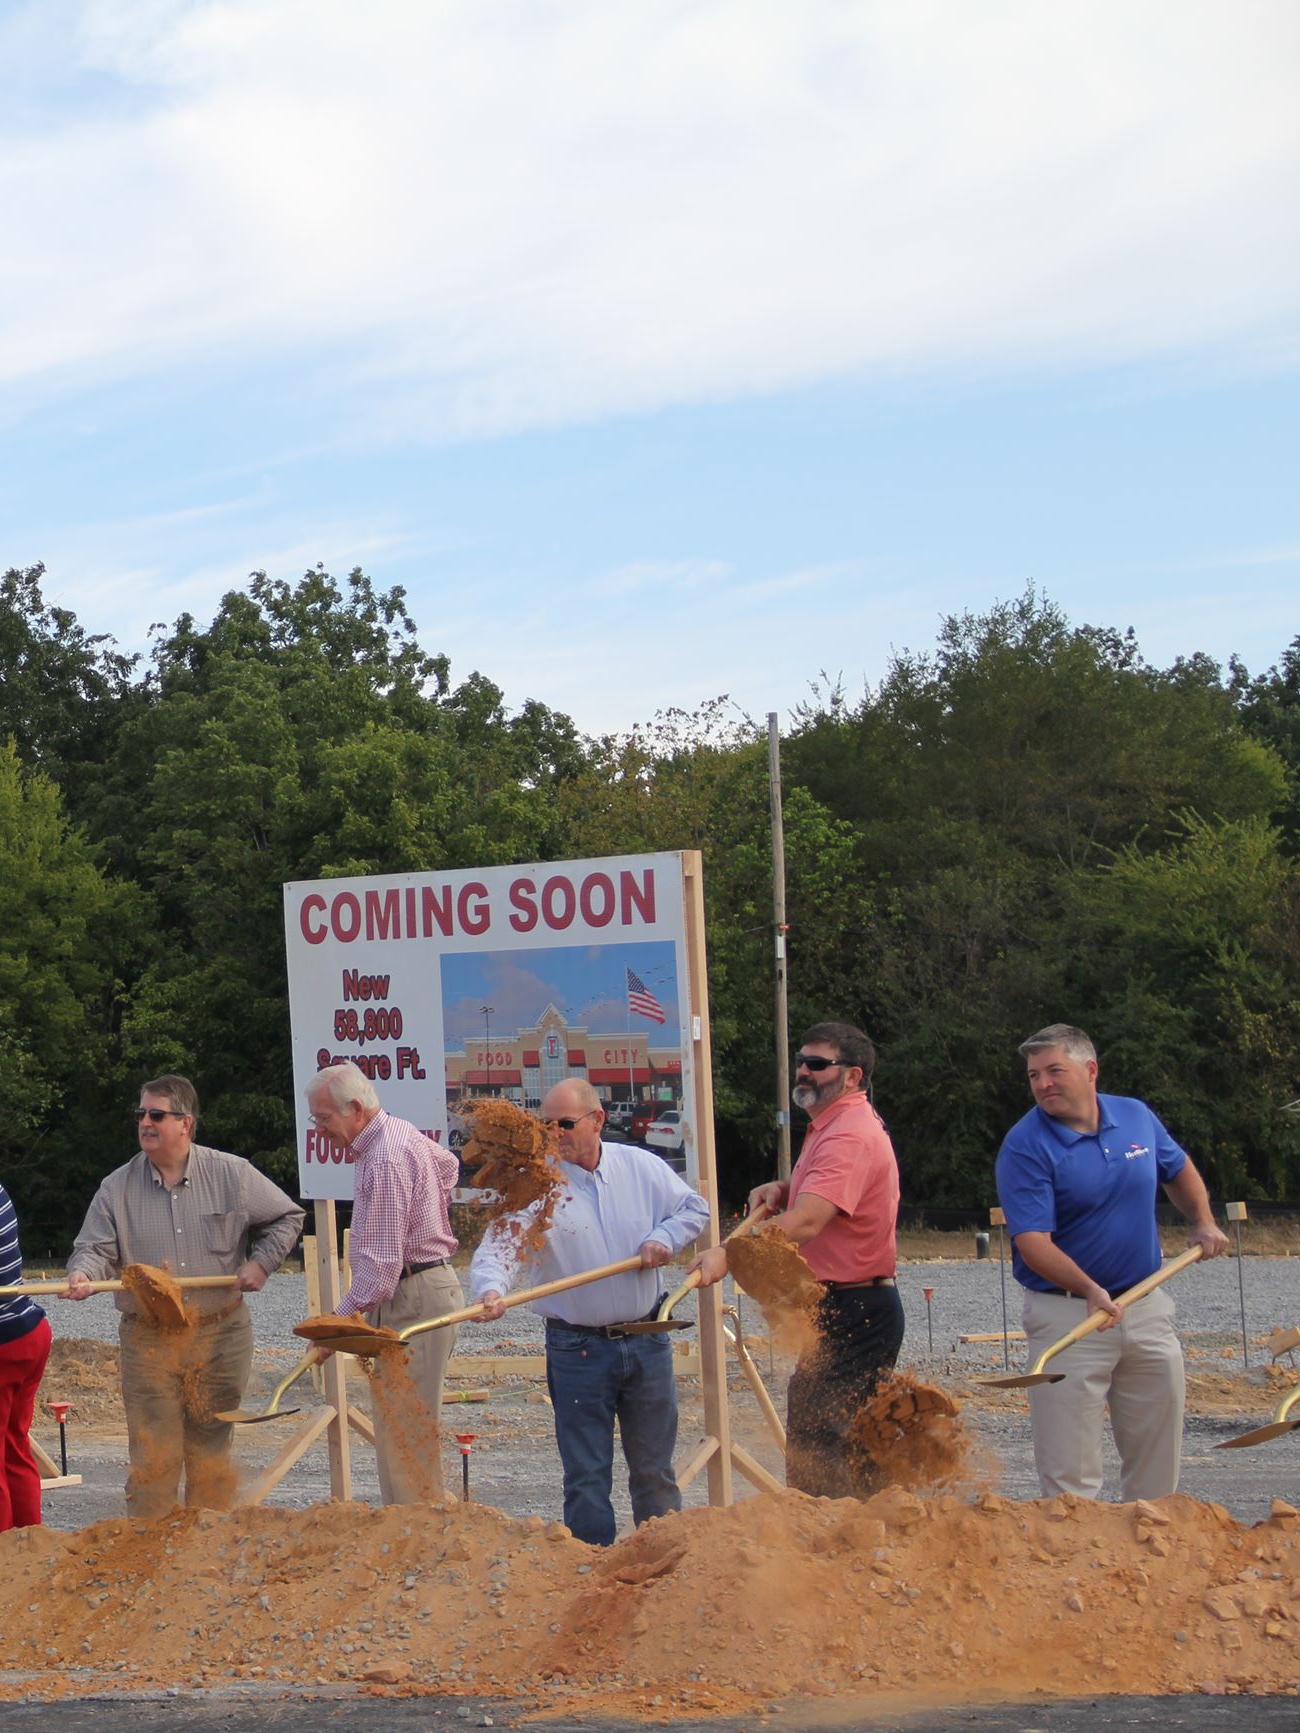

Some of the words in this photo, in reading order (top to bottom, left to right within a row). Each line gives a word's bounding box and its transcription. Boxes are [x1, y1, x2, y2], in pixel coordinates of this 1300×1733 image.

[300, 882, 491, 945] COMING
[509, 868, 656, 932] SOON
[342, 968, 390, 1001] New
[334, 1006, 403, 1046] 58,800
[316, 1048, 391, 1080] Sare
[396, 1047, 426, 1080] Ft.
[475, 1051, 512, 1066] FOOD
[603, 1048, 638, 1065] CITY
